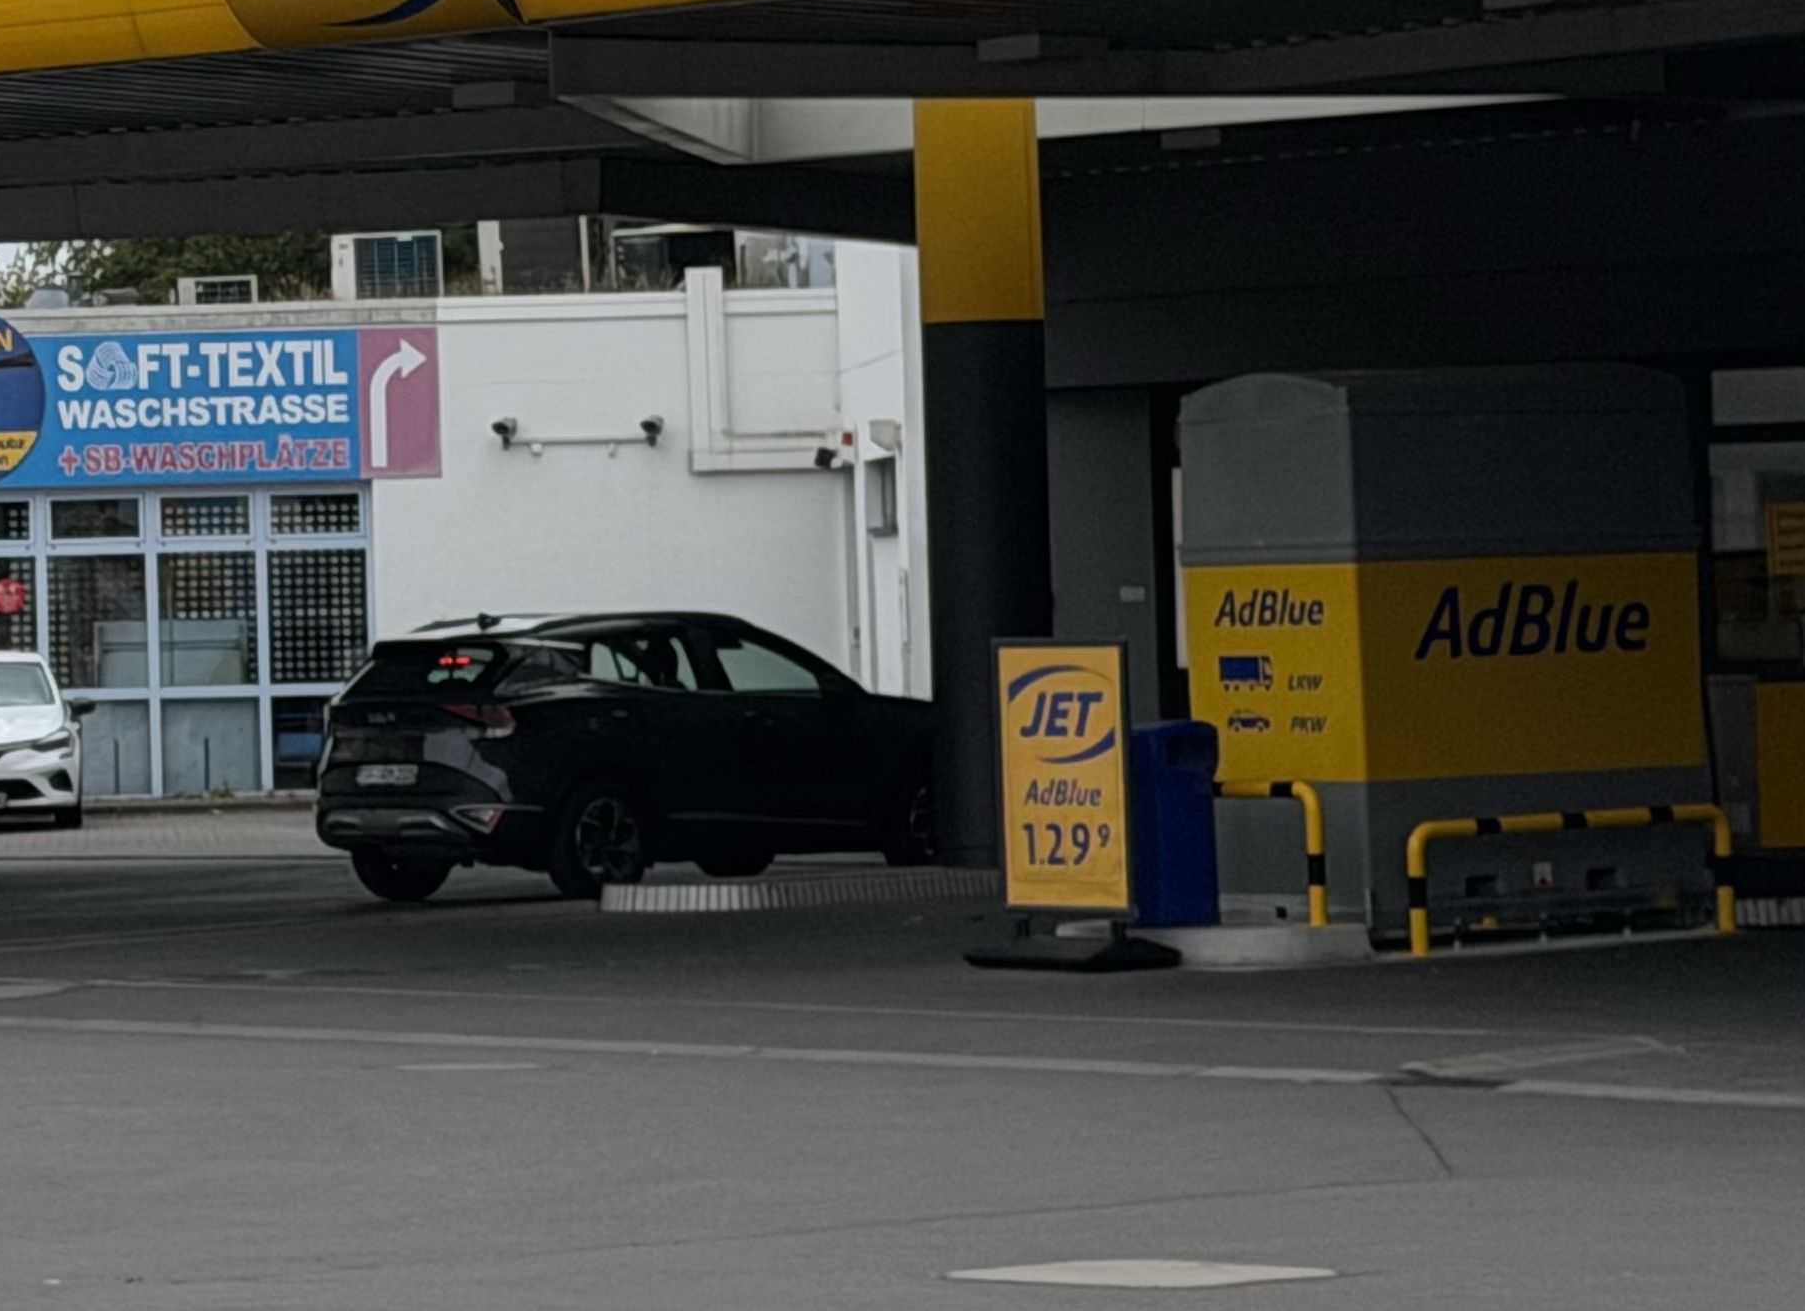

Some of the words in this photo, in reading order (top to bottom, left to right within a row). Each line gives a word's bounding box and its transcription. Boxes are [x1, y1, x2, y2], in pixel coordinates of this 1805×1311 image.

[57, 393, 350, 430] WASCHSTRASSE
[1215, 588, 1325, 627] AdBlue
[1414, 580, 1650, 660] AdBlue
[1020, 692, 1103, 738] JET
[1024, 779, 1102, 807] AdBlue
